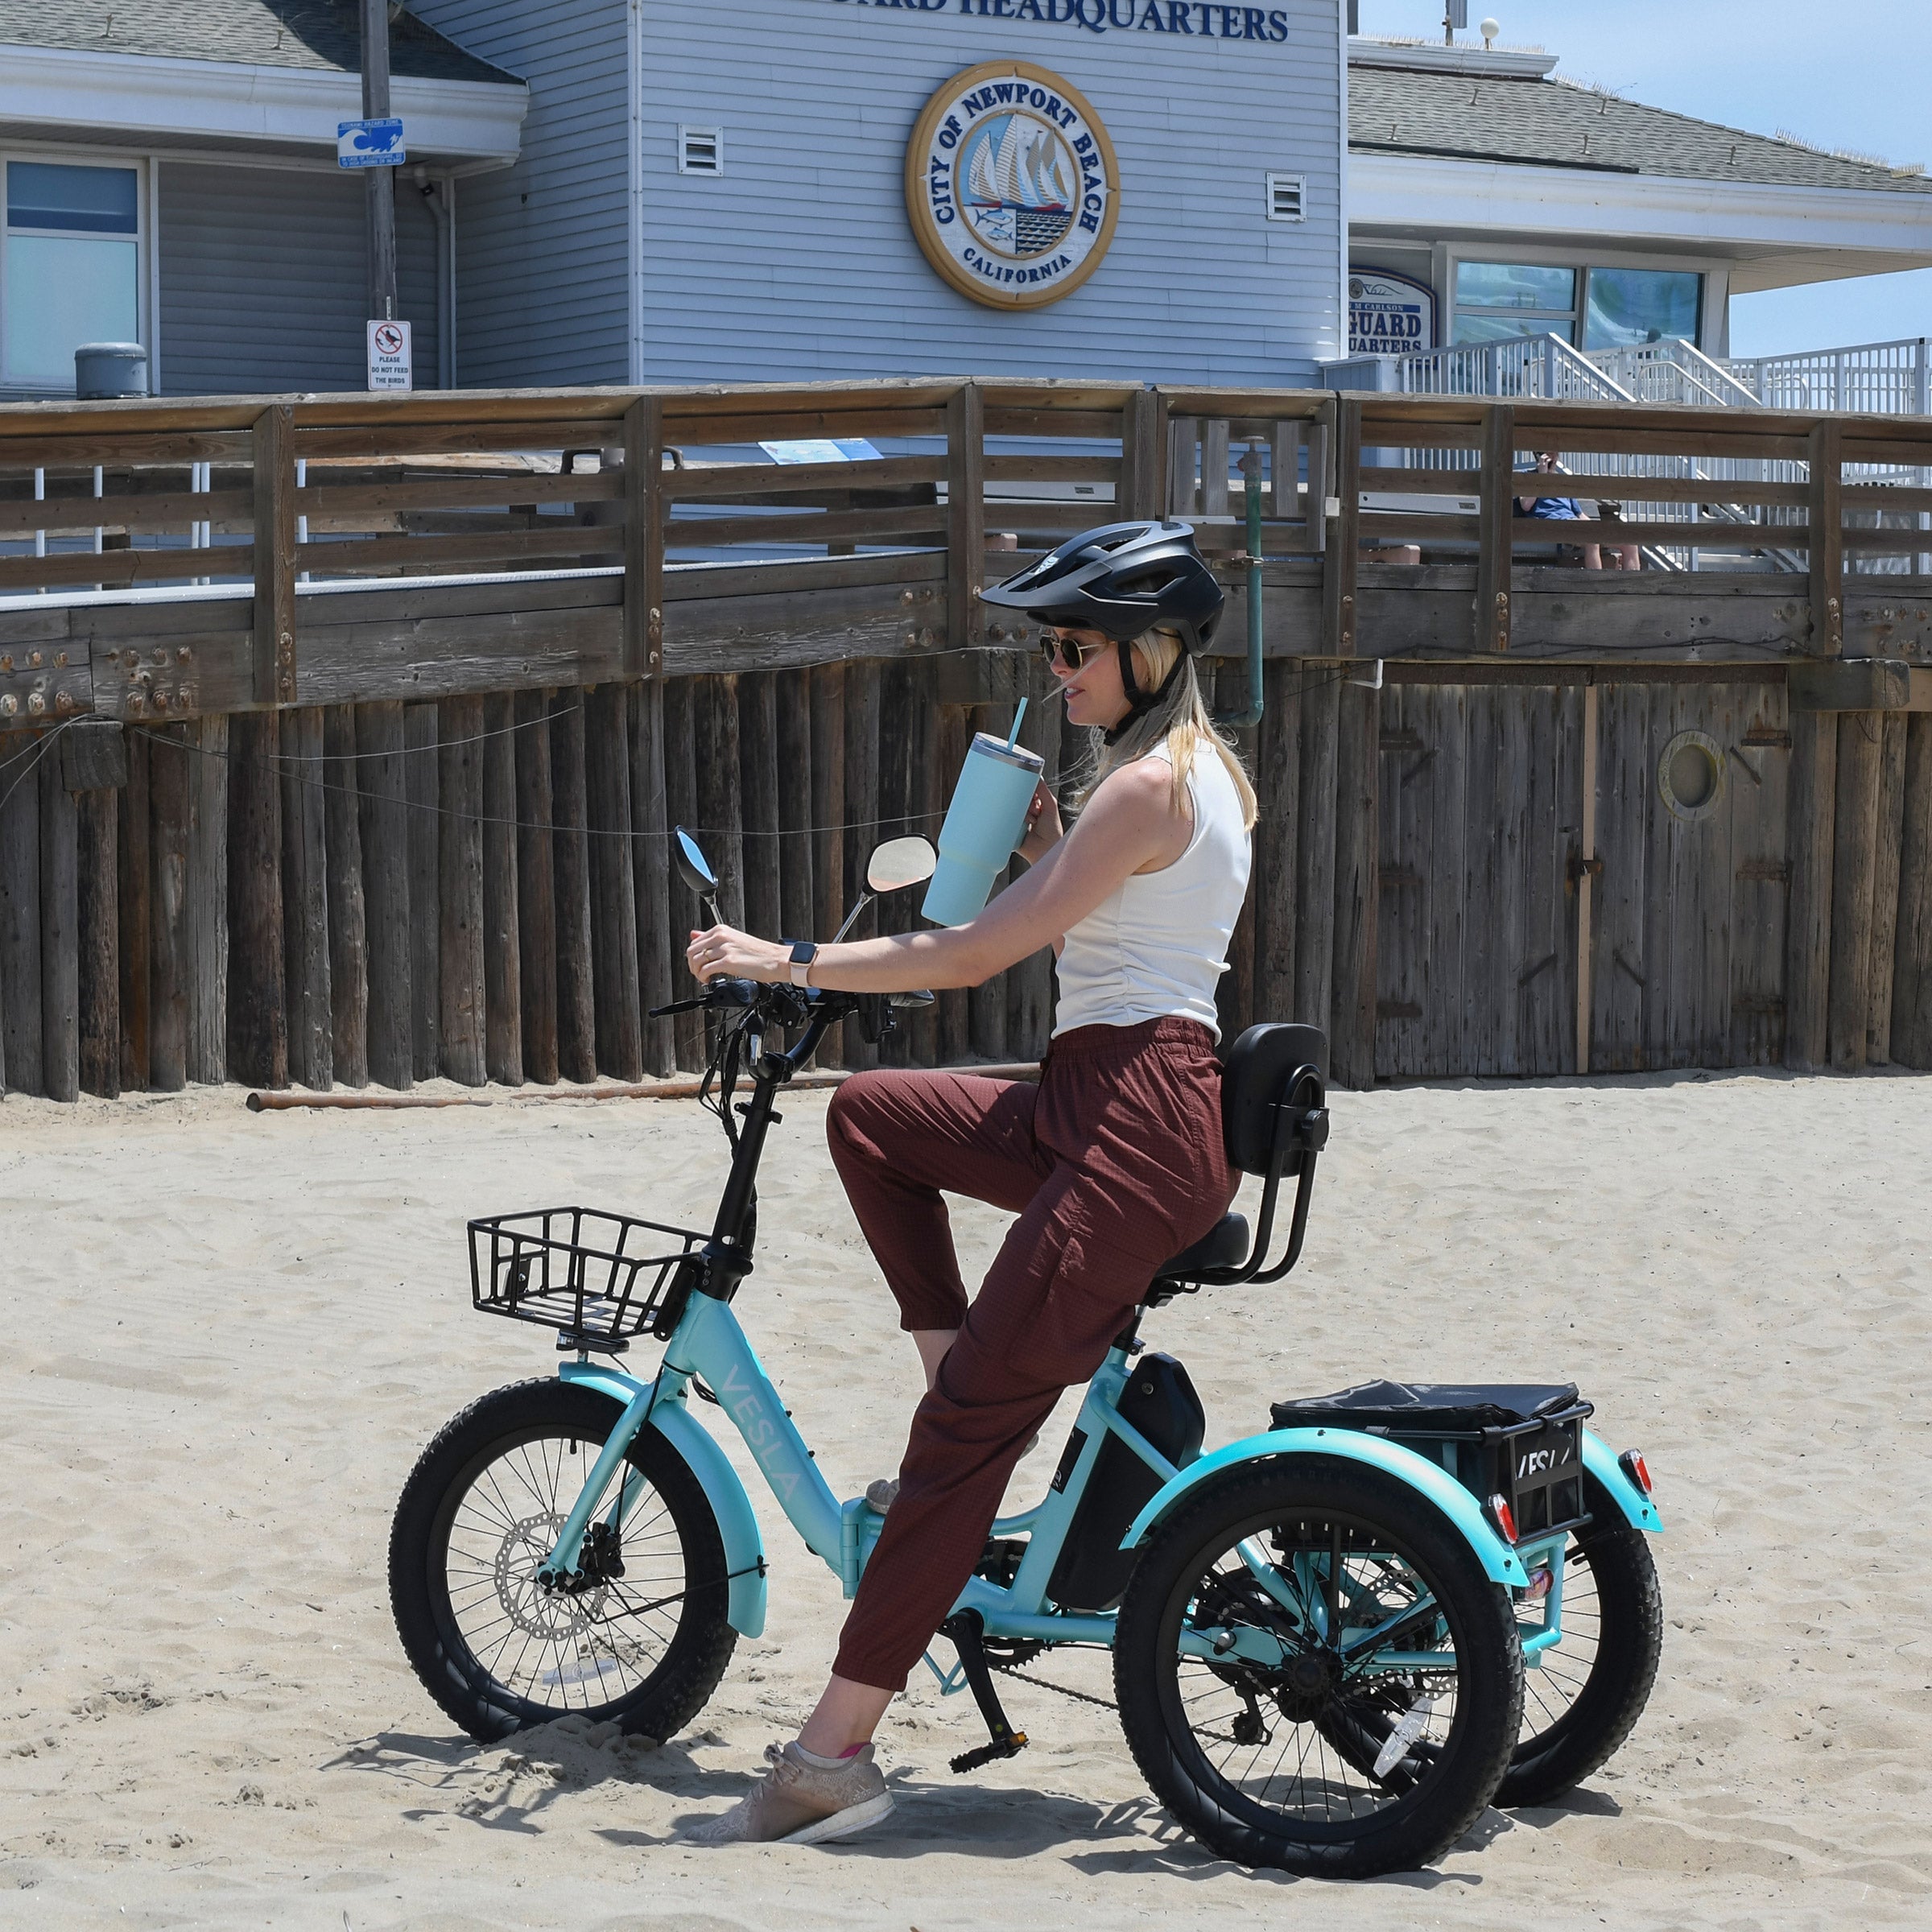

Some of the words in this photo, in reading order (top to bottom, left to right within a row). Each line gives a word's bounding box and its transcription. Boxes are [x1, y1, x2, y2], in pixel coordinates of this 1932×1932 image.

[961, 83, 1077, 130] NEWPORT
[938, 114, 964, 149] OF
[931, 155, 955, 225] CITY
[1072, 133, 1103, 233] BEACH
[964, 247, 1071, 283] CALIFORNIA
[1349, 312, 1422, 336] GUARD
[1365, 303, 1404, 312] CARLSON
[721, 1364, 800, 1501] VESLA
